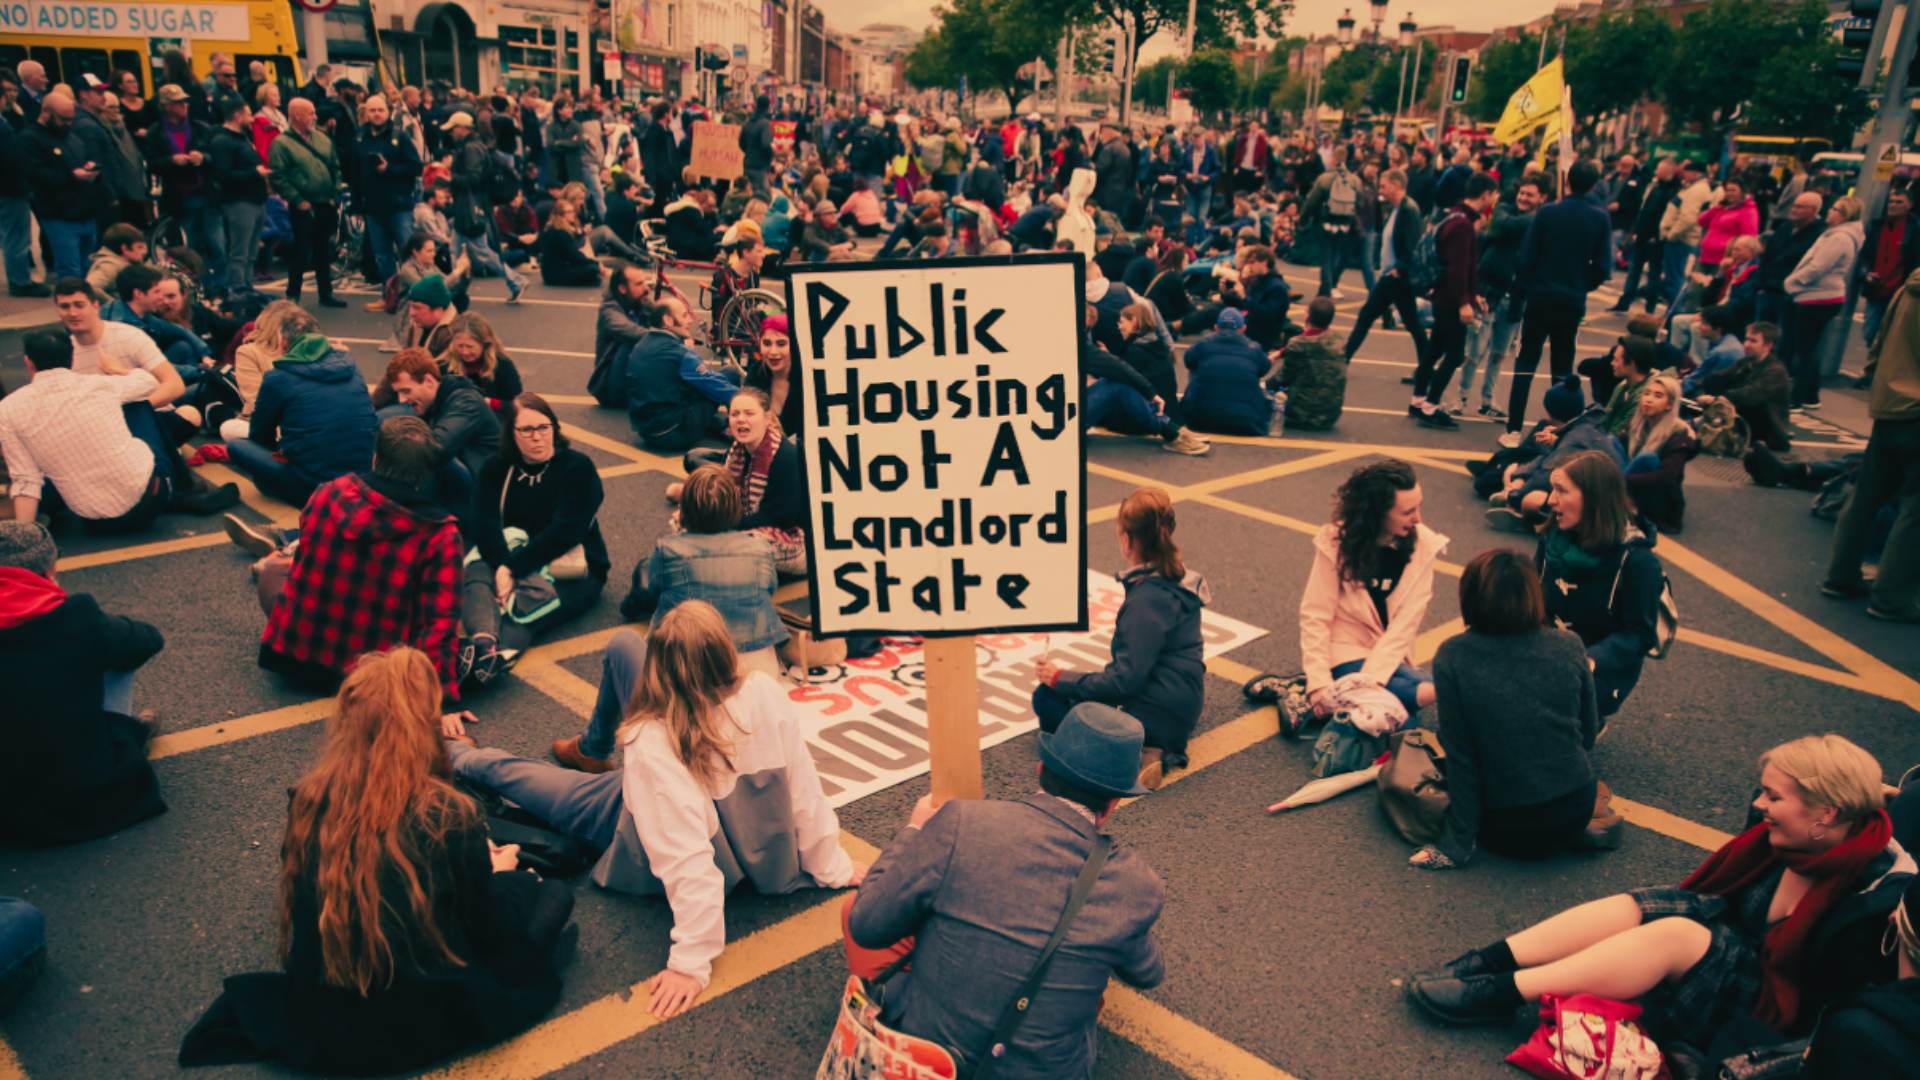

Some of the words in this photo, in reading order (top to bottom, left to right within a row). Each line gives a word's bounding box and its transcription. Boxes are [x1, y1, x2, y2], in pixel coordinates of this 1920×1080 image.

[0, 4, 28, 27] NO
[37, 5, 118, 30] ADDED
[127, 8, 214, 33] SUGAR
[699, 149, 738, 163] HUMAN
[806, 282, 1007, 359] Public
[813, 364, 1077, 440] Housing,
[818, 429, 951, 494] Not
[981, 421, 1030, 487] A
[821, 490, 1067, 555] Landlord
[833, 558, 1030, 616] State
